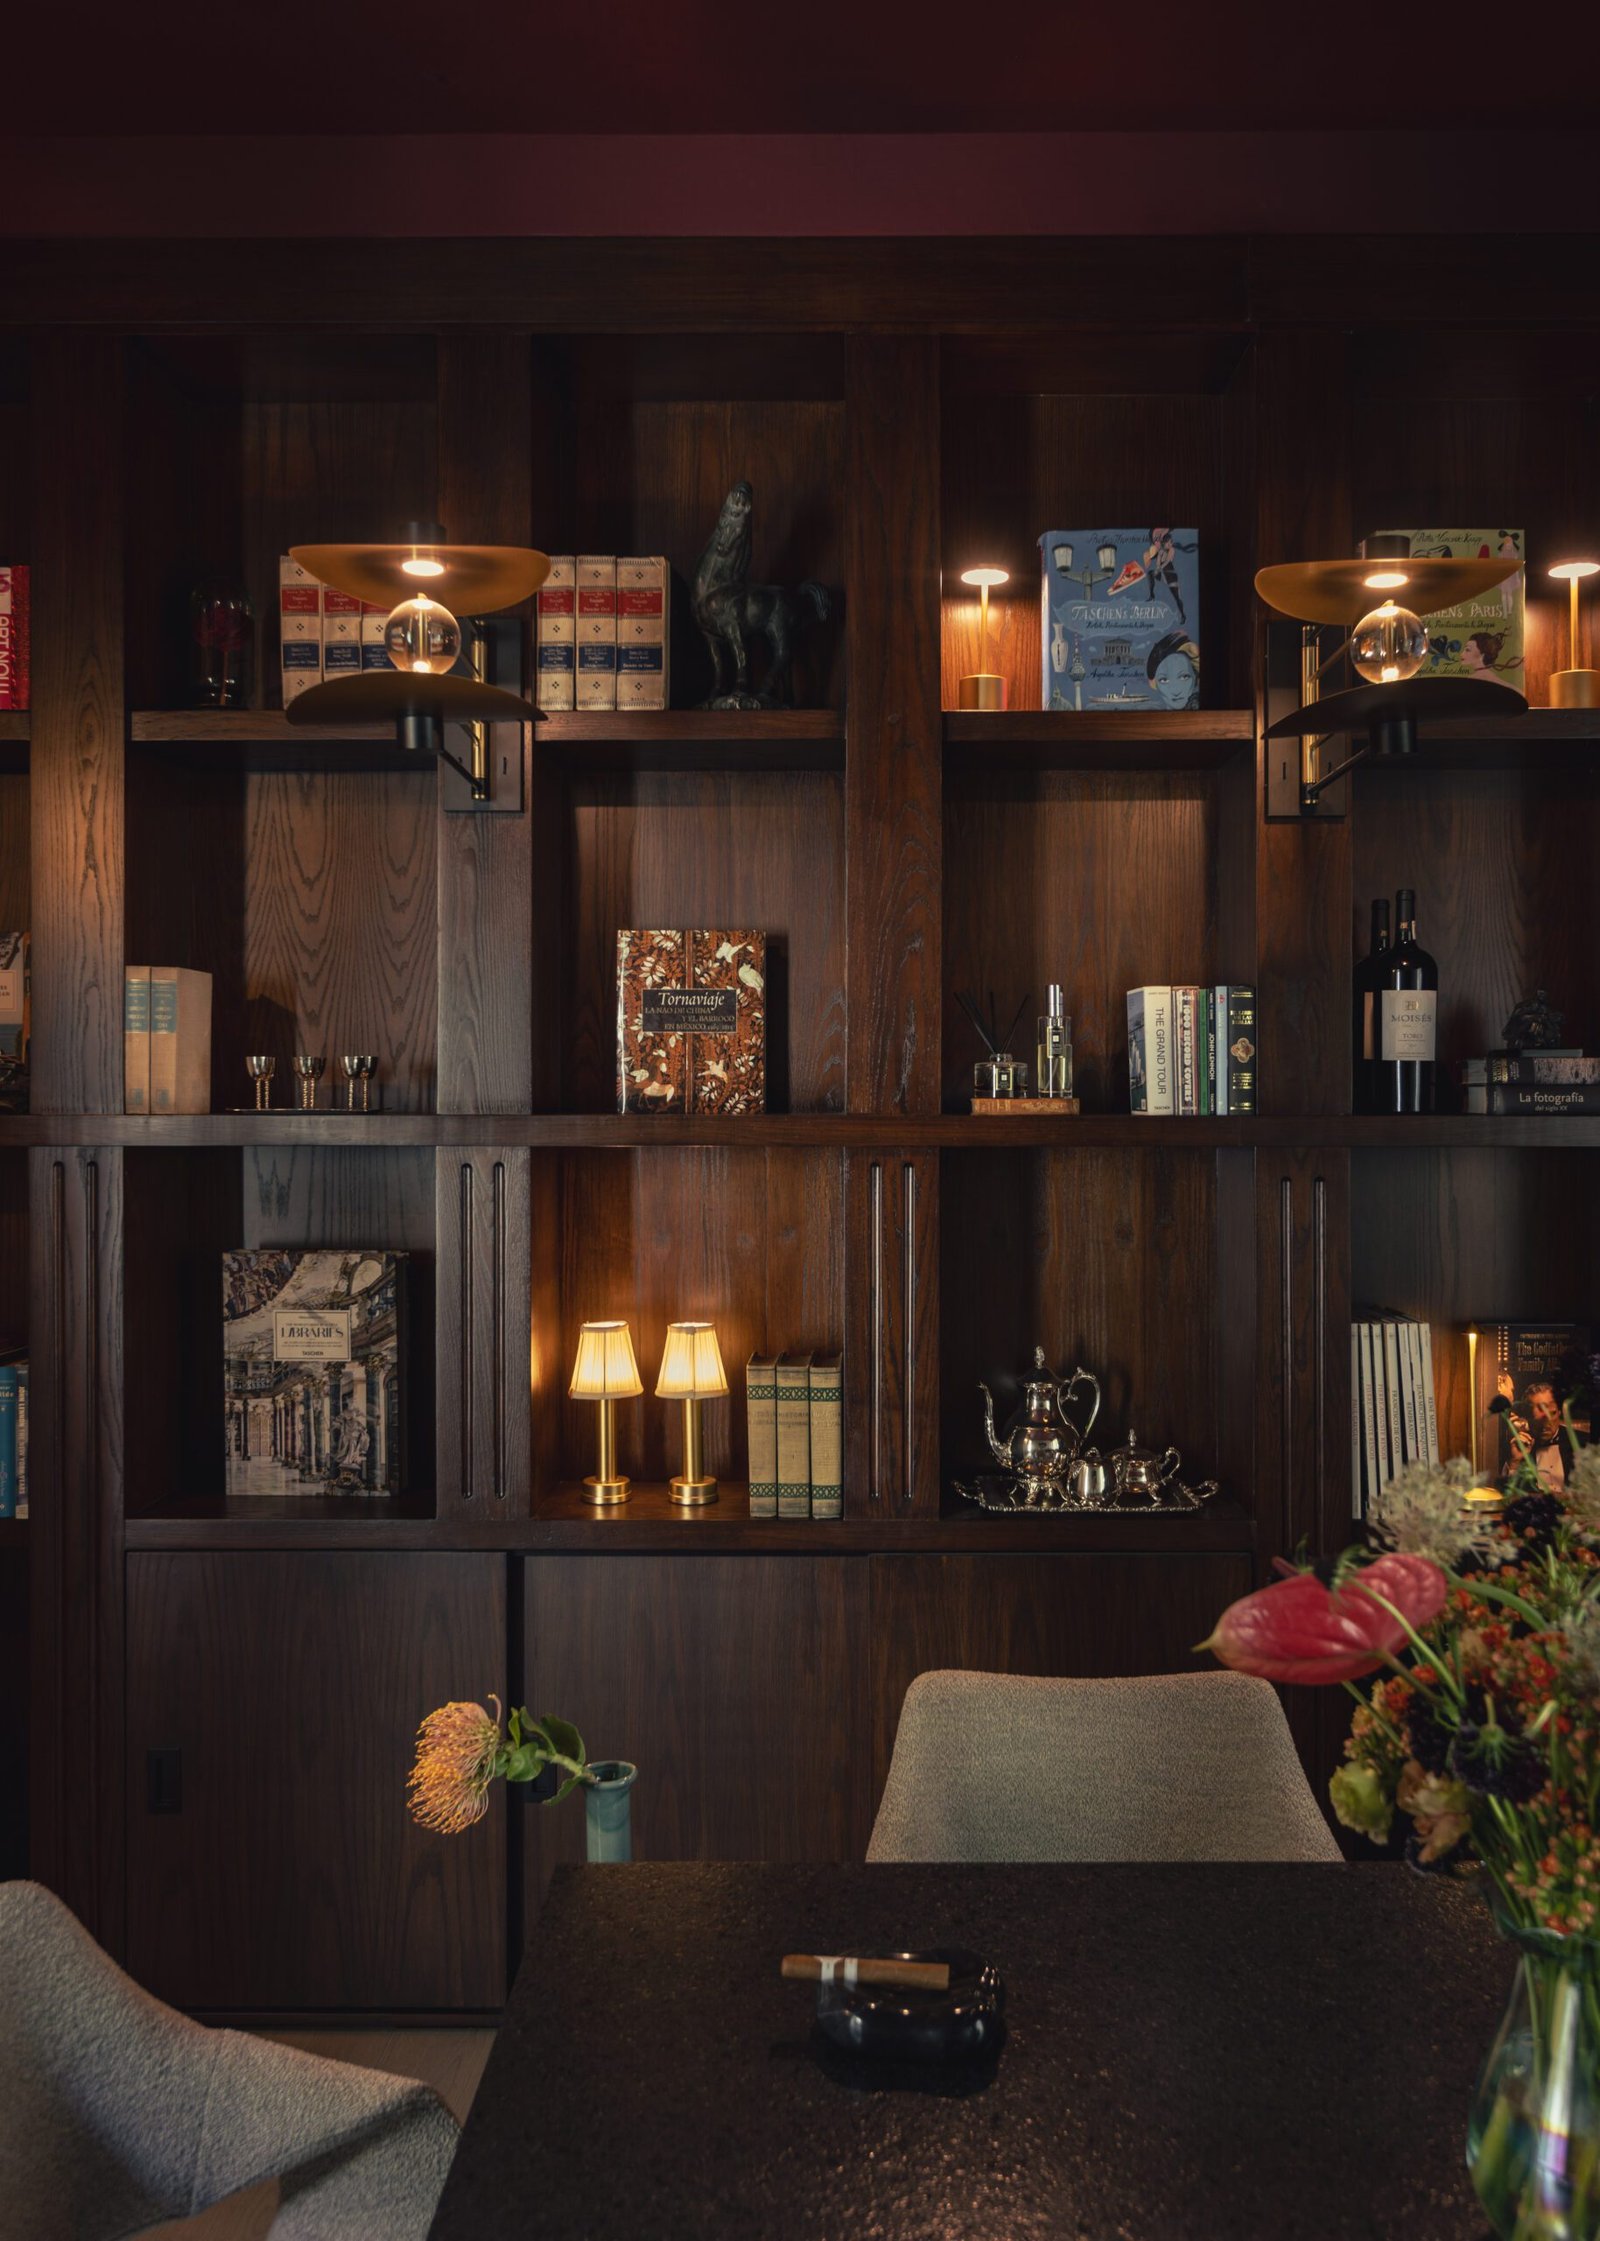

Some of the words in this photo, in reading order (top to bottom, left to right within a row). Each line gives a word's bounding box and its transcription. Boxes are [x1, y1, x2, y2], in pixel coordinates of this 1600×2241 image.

[1130, 605, 1169, 620] BERLIN
[1471, 603, 1504, 618] PARIS
[658, 992, 725, 1011] Tornaviaje
[676, 1022, 706, 1030] MÉXICO
[1155, 1008, 1165, 1026] THE
[1183, 1005, 1191, 1028] 1000
[1391, 1013, 1432, 1023] MOISÉS
[1156, 1028, 1165, 1064] GRAND
[1183, 1029, 1192, 1066] RECORD
[1157, 1067, 1167, 1095] TOUR
[1184, 1067, 1192, 1102] COVERS
[1519, 1093, 1531, 1103] La
[1534, 1092, 1584, 1105] fotografía
[1406, 1402, 1414, 1440] REMBRANDT
